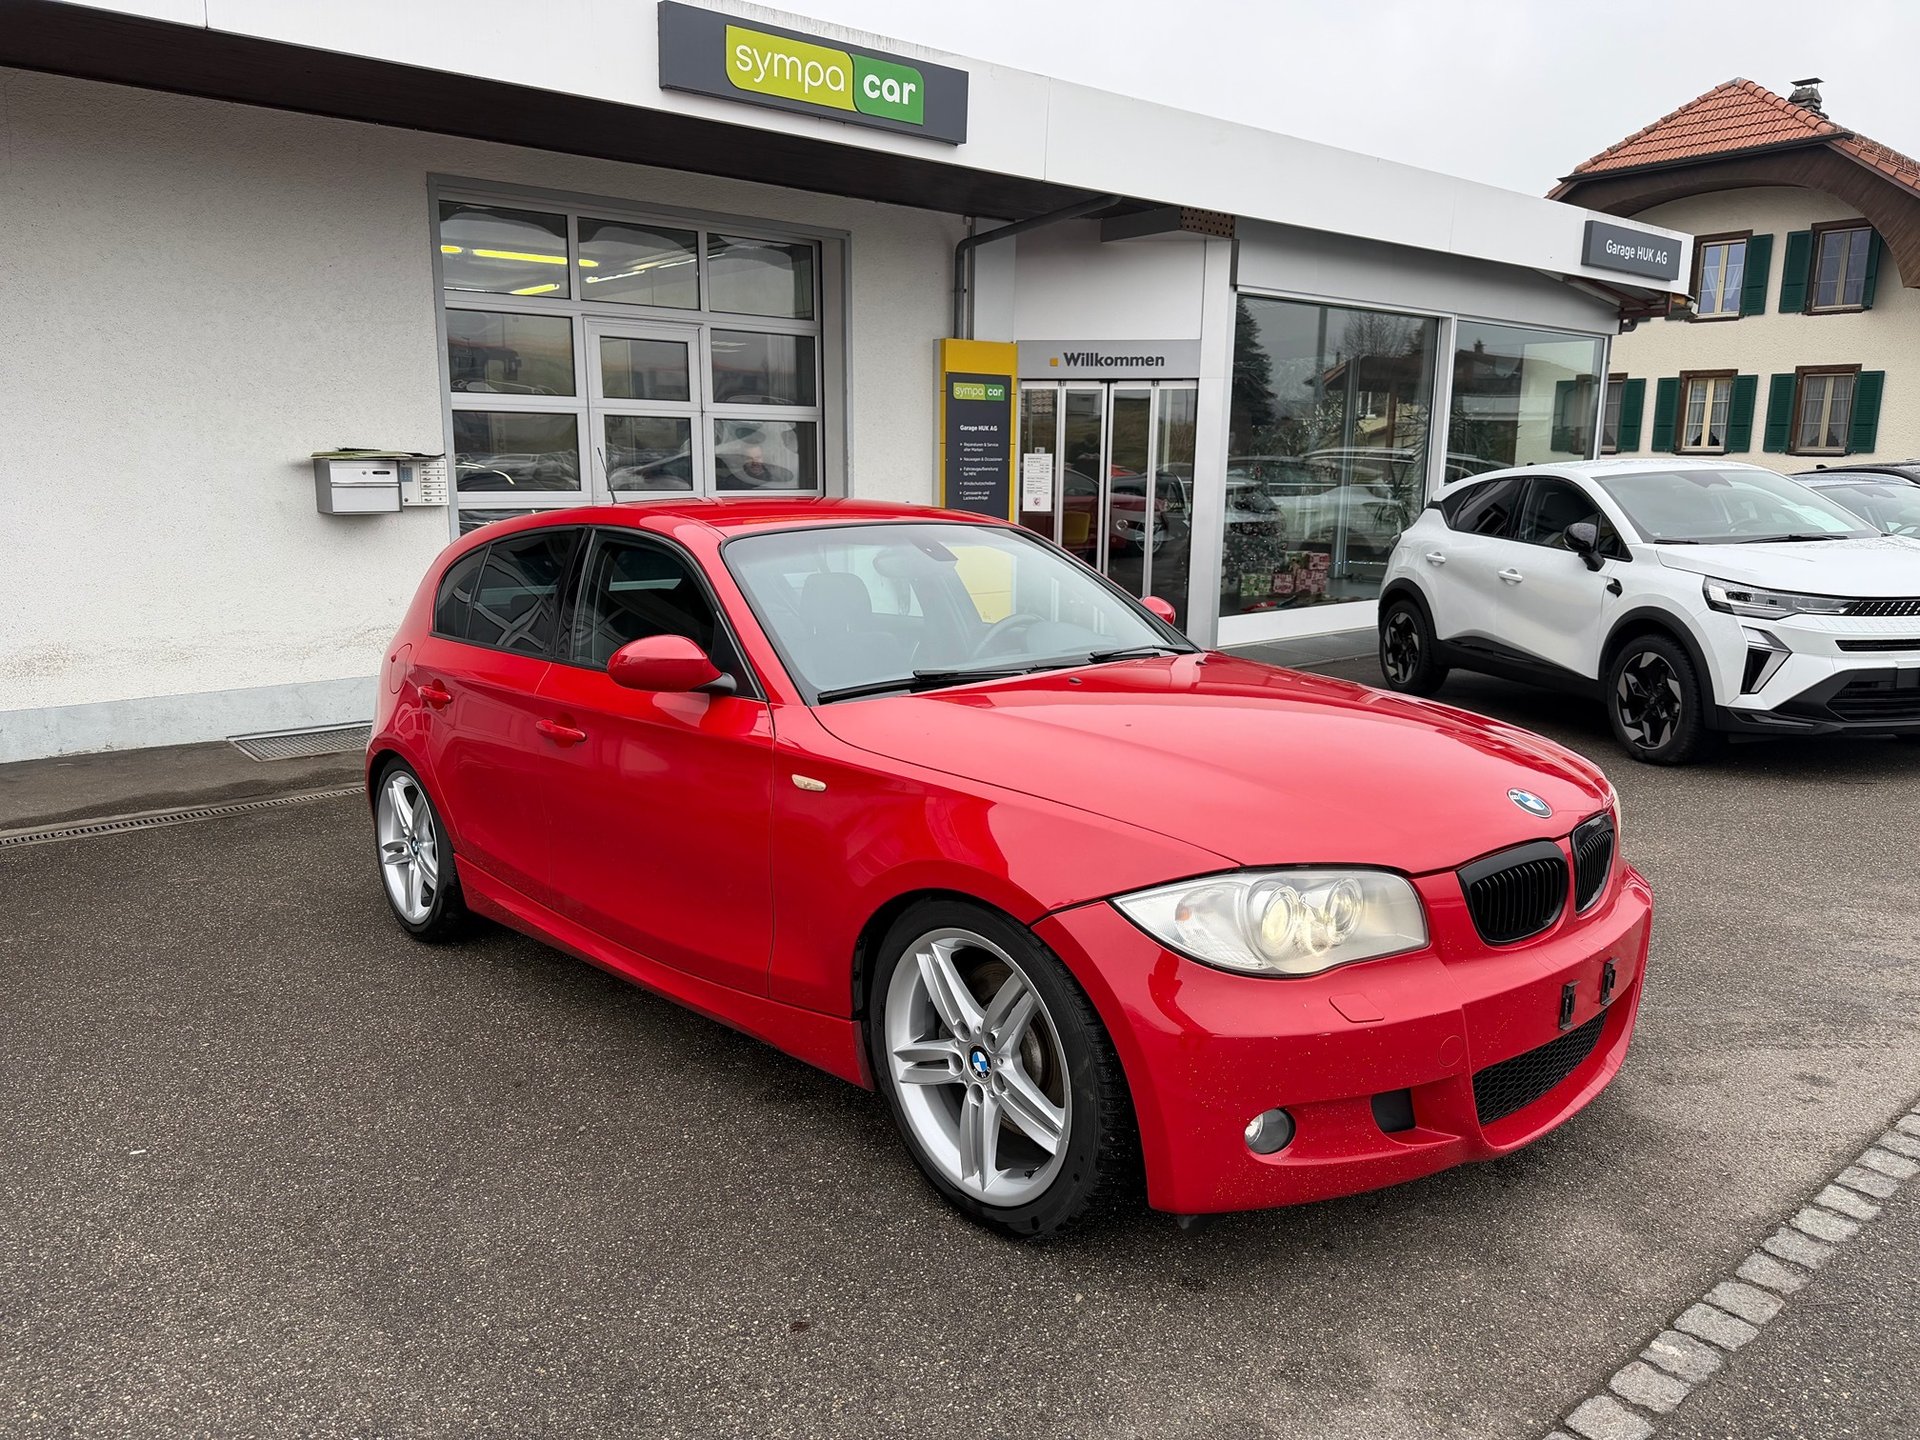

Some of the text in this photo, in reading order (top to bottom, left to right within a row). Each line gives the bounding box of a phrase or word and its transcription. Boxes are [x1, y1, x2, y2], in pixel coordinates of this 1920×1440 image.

[735, 44, 916, 105] sympa car
[1606, 239, 1668, 265] Garage HUK AG
[1063, 352, 1165, 367] Willkommen
[955, 386, 1003, 397] sympa car
[959, 424, 978, 432] Garage
